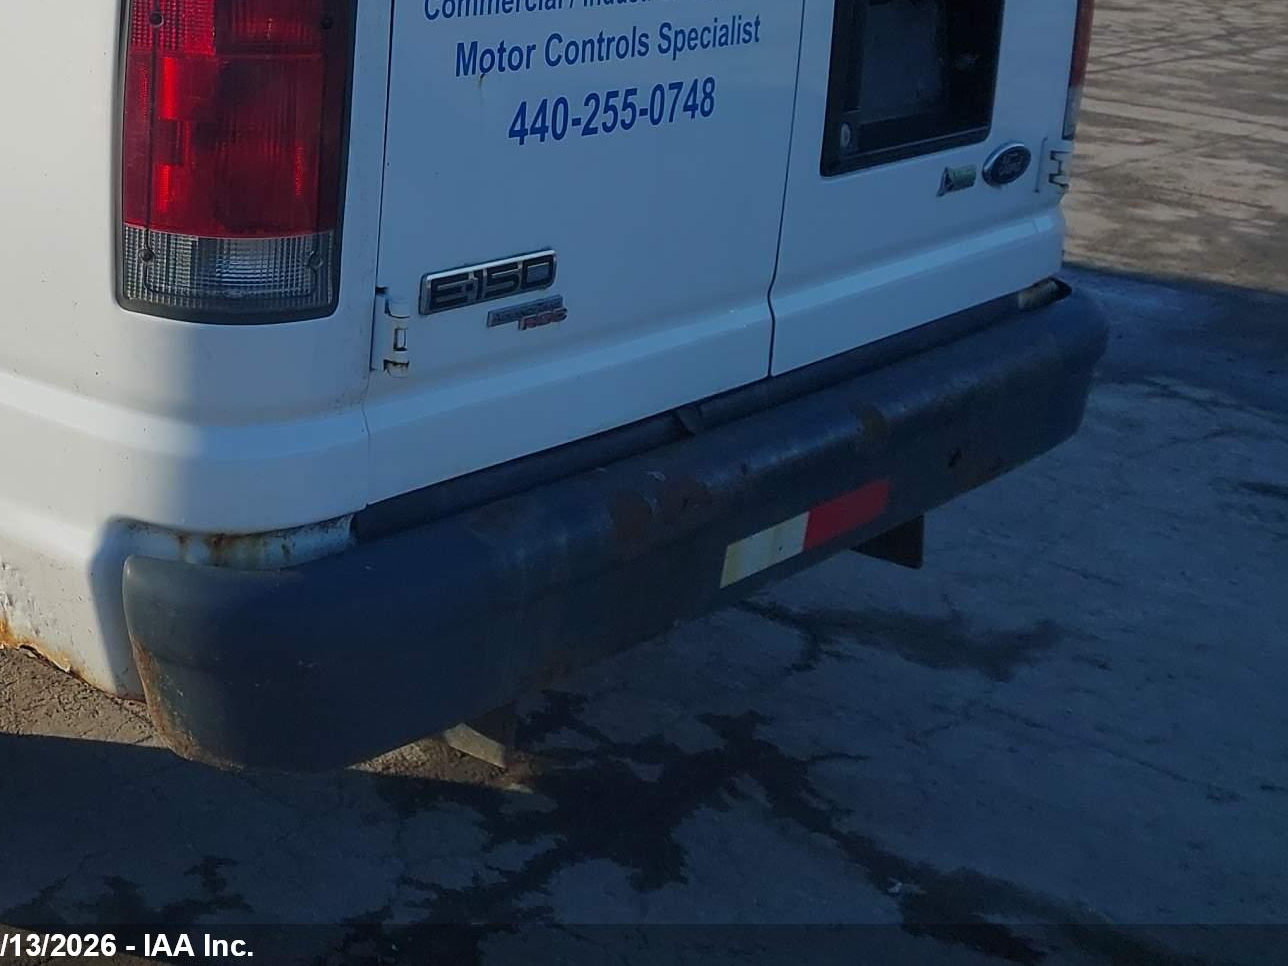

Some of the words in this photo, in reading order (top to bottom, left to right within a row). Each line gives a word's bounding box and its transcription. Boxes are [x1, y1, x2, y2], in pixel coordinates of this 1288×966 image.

[455, 41, 536, 77] Motor
[544, 25, 650, 67] Controls
[658, 14, 761, 61] Specialist
[508, 76, 716, 146] 440-255-0748
